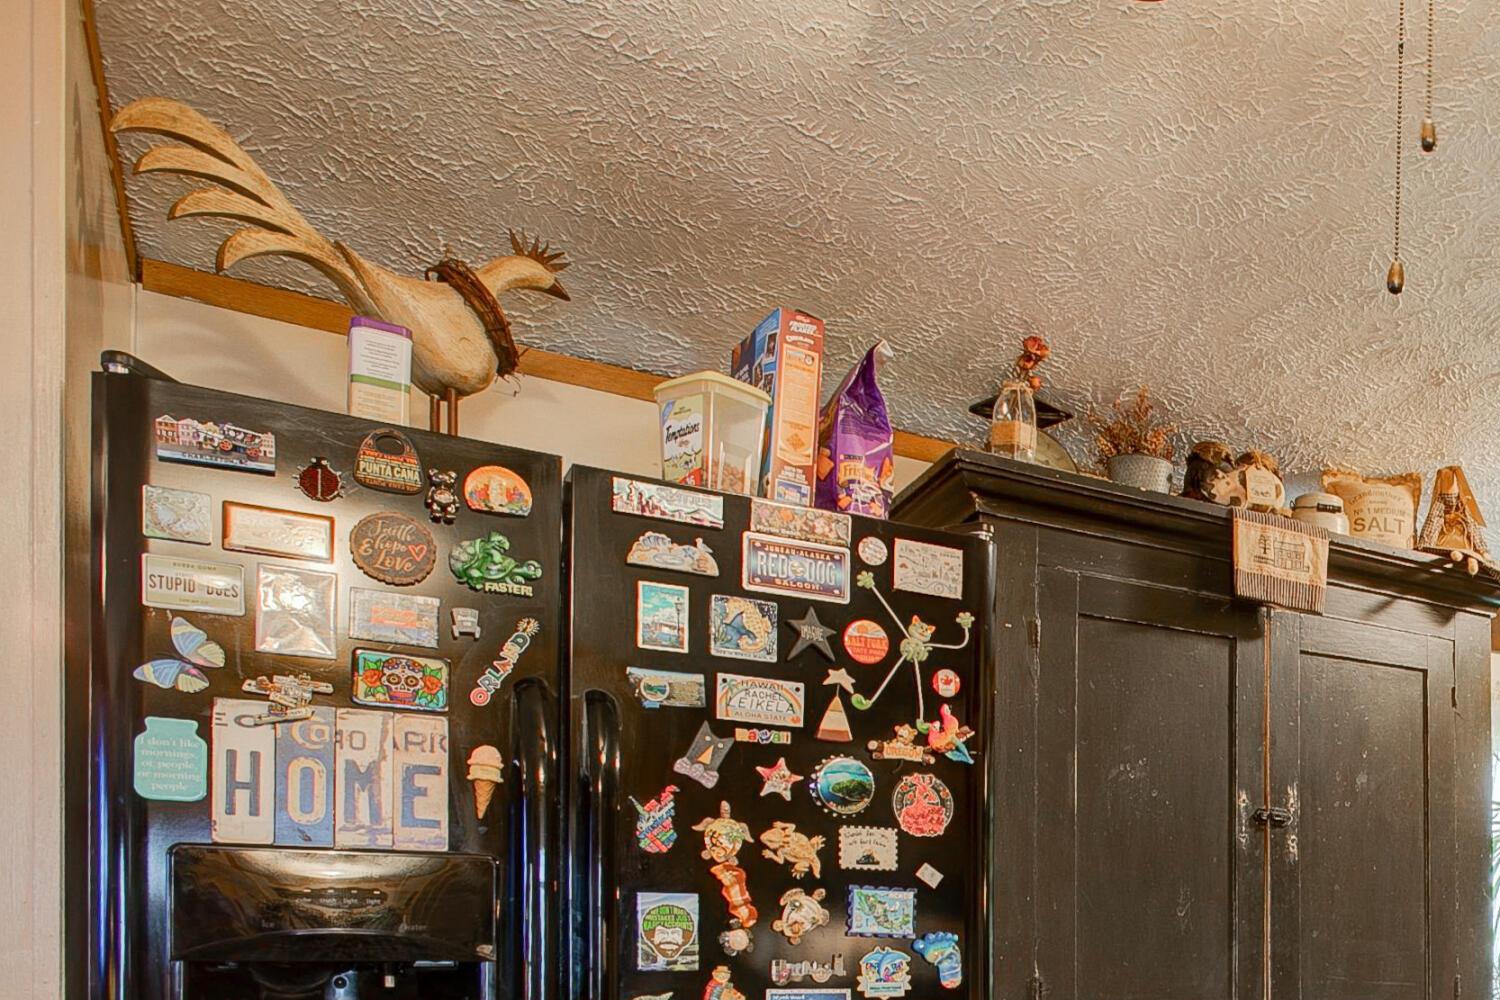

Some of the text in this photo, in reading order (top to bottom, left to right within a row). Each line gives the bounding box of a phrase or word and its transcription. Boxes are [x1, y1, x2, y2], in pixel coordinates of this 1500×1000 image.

[665, 422, 700, 445] Temptations
[359, 462, 421, 482] PUNTA CANA
[373, 519, 417, 541] Faith
[1353, 516, 1405, 535] SALT
[374, 550, 416, 572] Love
[757, 551, 836, 585] RED DOG
[149, 573, 196, 593] STUPID
[485, 582, 533, 598] FASTER!
[740, 679, 784, 691] HAWAII
[744, 690, 783, 701] RACHEL
[734, 710, 762, 719] ALOHA
[224, 748, 442, 829] HOME
